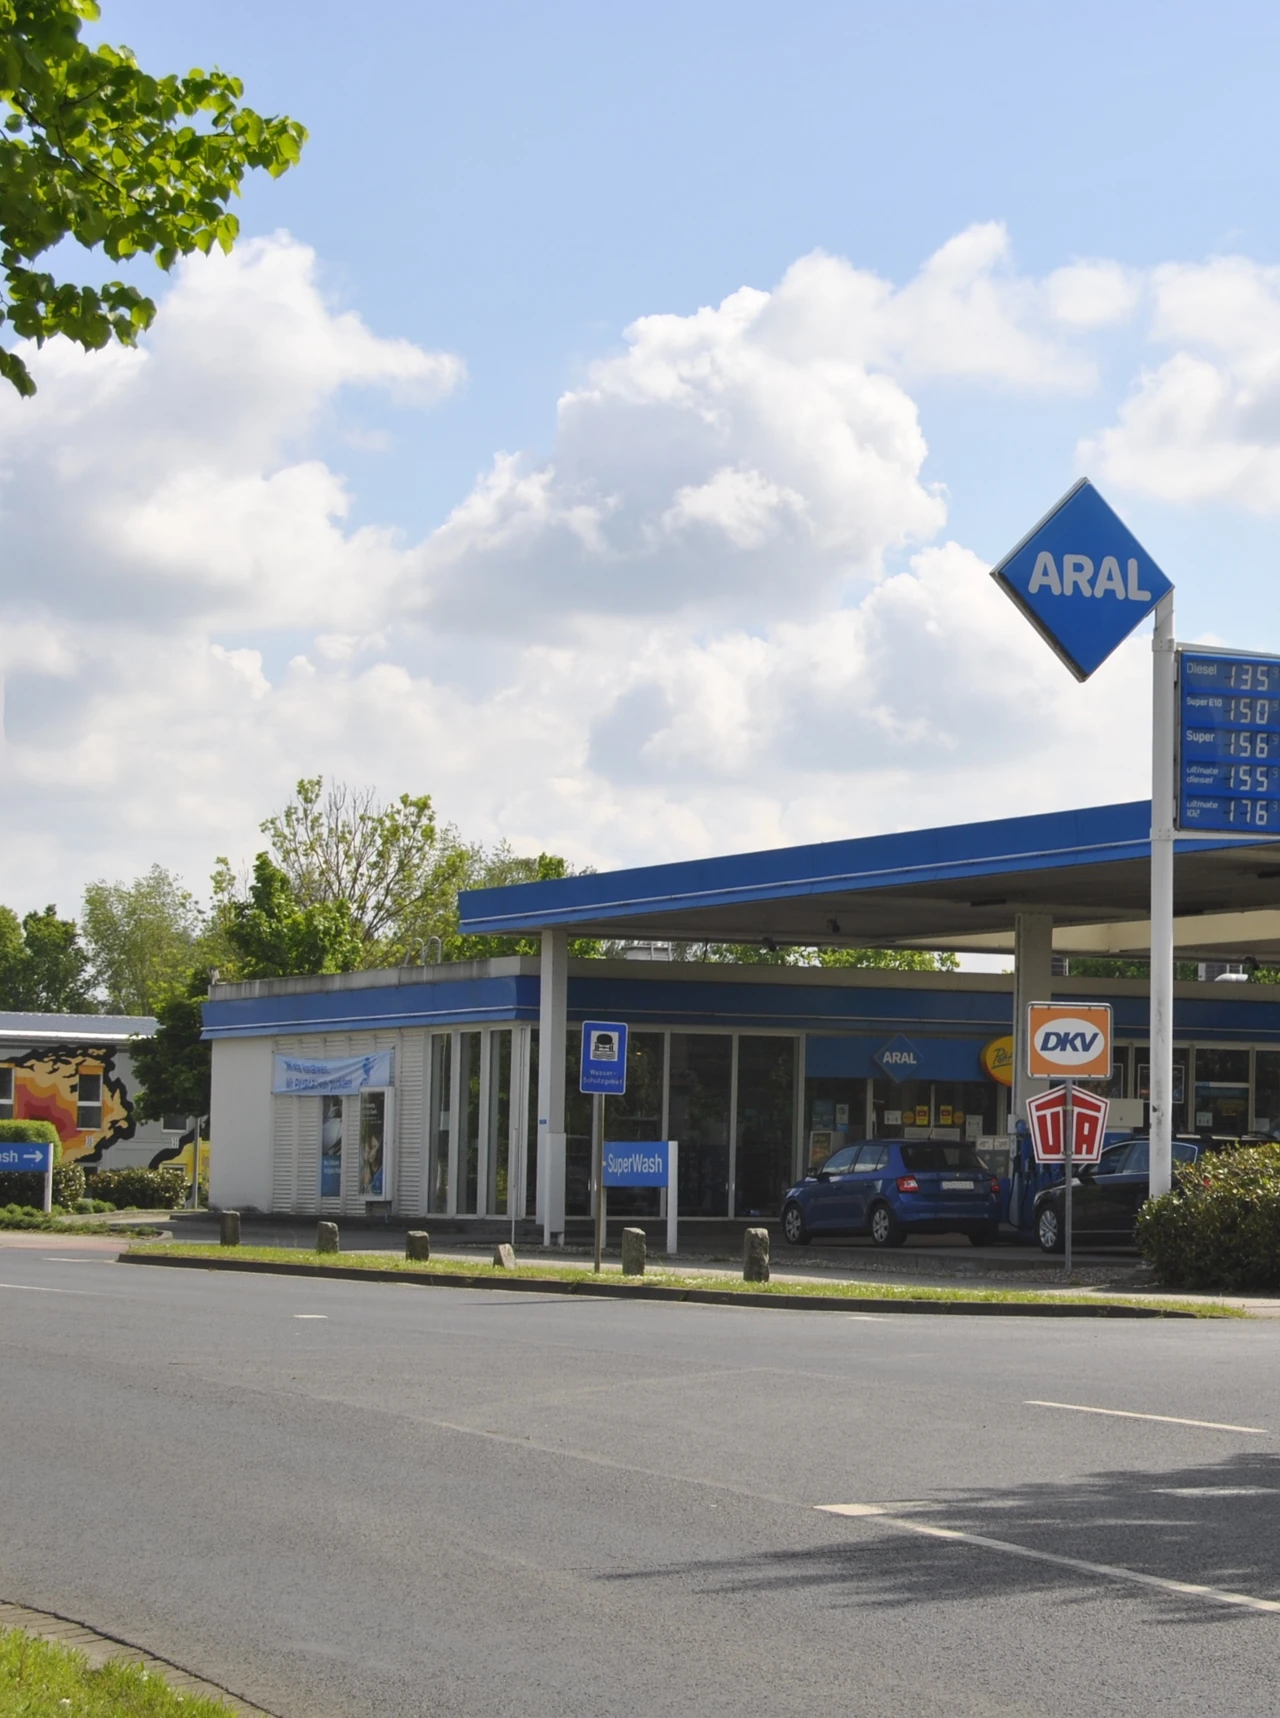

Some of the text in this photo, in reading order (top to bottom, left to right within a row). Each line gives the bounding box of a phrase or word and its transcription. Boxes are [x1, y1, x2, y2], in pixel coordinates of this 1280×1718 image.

[1028, 551, 1151, 602] ARAL
[1187, 662, 1217, 675] Diesel
[1230, 664, 1269, 691] 135
[1186, 697, 1208, 707] Super
[1209, 698, 1222, 707] E10
[1230, 698, 1269, 724] 150
[1186, 730, 1215, 743] Super
[1230, 732, 1269, 758] 156
[1187, 766, 1219, 775] ultimate
[1187, 776, 1214, 784] diesel
[1230, 766, 1268, 792] 155
[1187, 800, 1219, 809] ultimate
[1230, 800, 1268, 825] 176
[1039, 1031, 1099, 1052] DKV
[882, 1051, 917, 1064] ARAL
[608, 1153, 663, 1177] SuperWash
